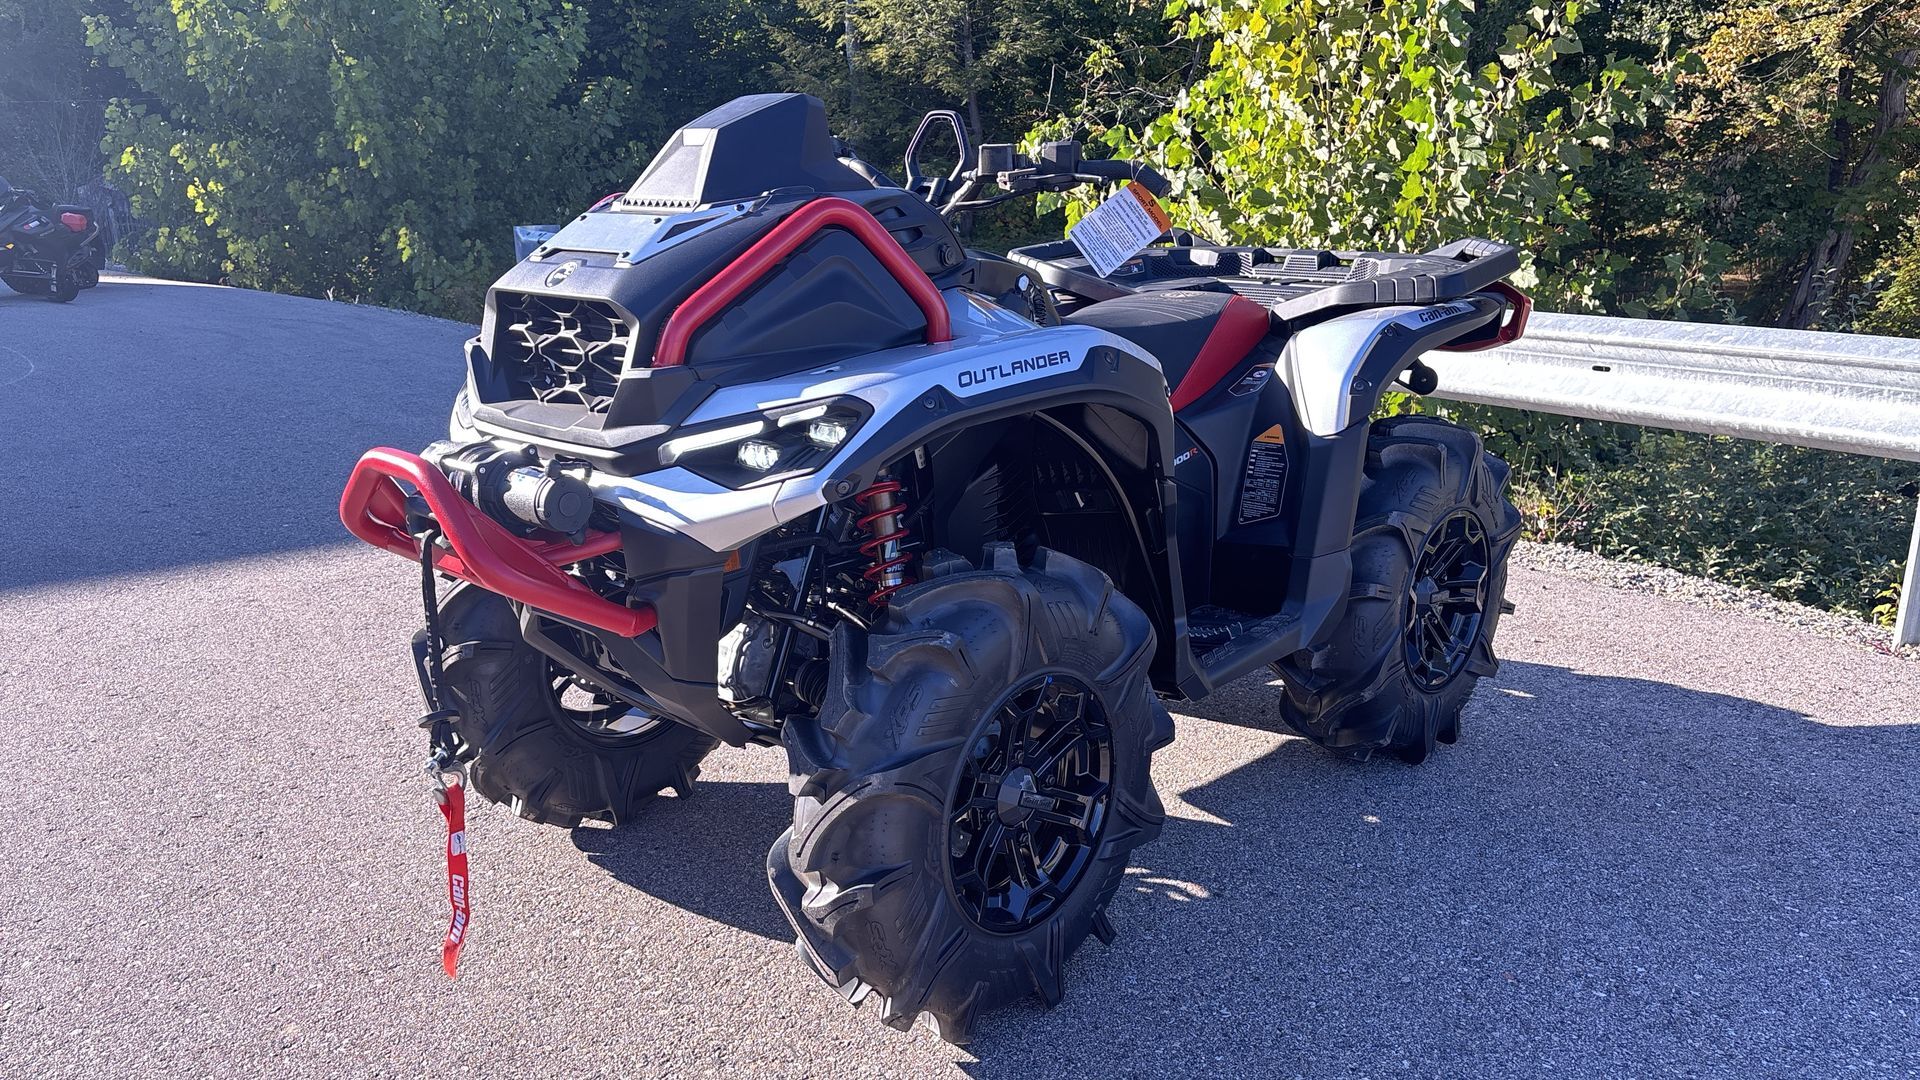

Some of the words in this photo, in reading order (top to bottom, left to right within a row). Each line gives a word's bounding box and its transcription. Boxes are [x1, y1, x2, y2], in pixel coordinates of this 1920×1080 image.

[1133, 188, 1149, 207] SPORT
[1147, 207, 1163, 229] MODEL
[1148, 198, 1156, 207] S
[1418, 306, 1462, 323] can-am
[958, 350, 1071, 388] OUTLANDER
[450, 873, 467, 945] can-am
